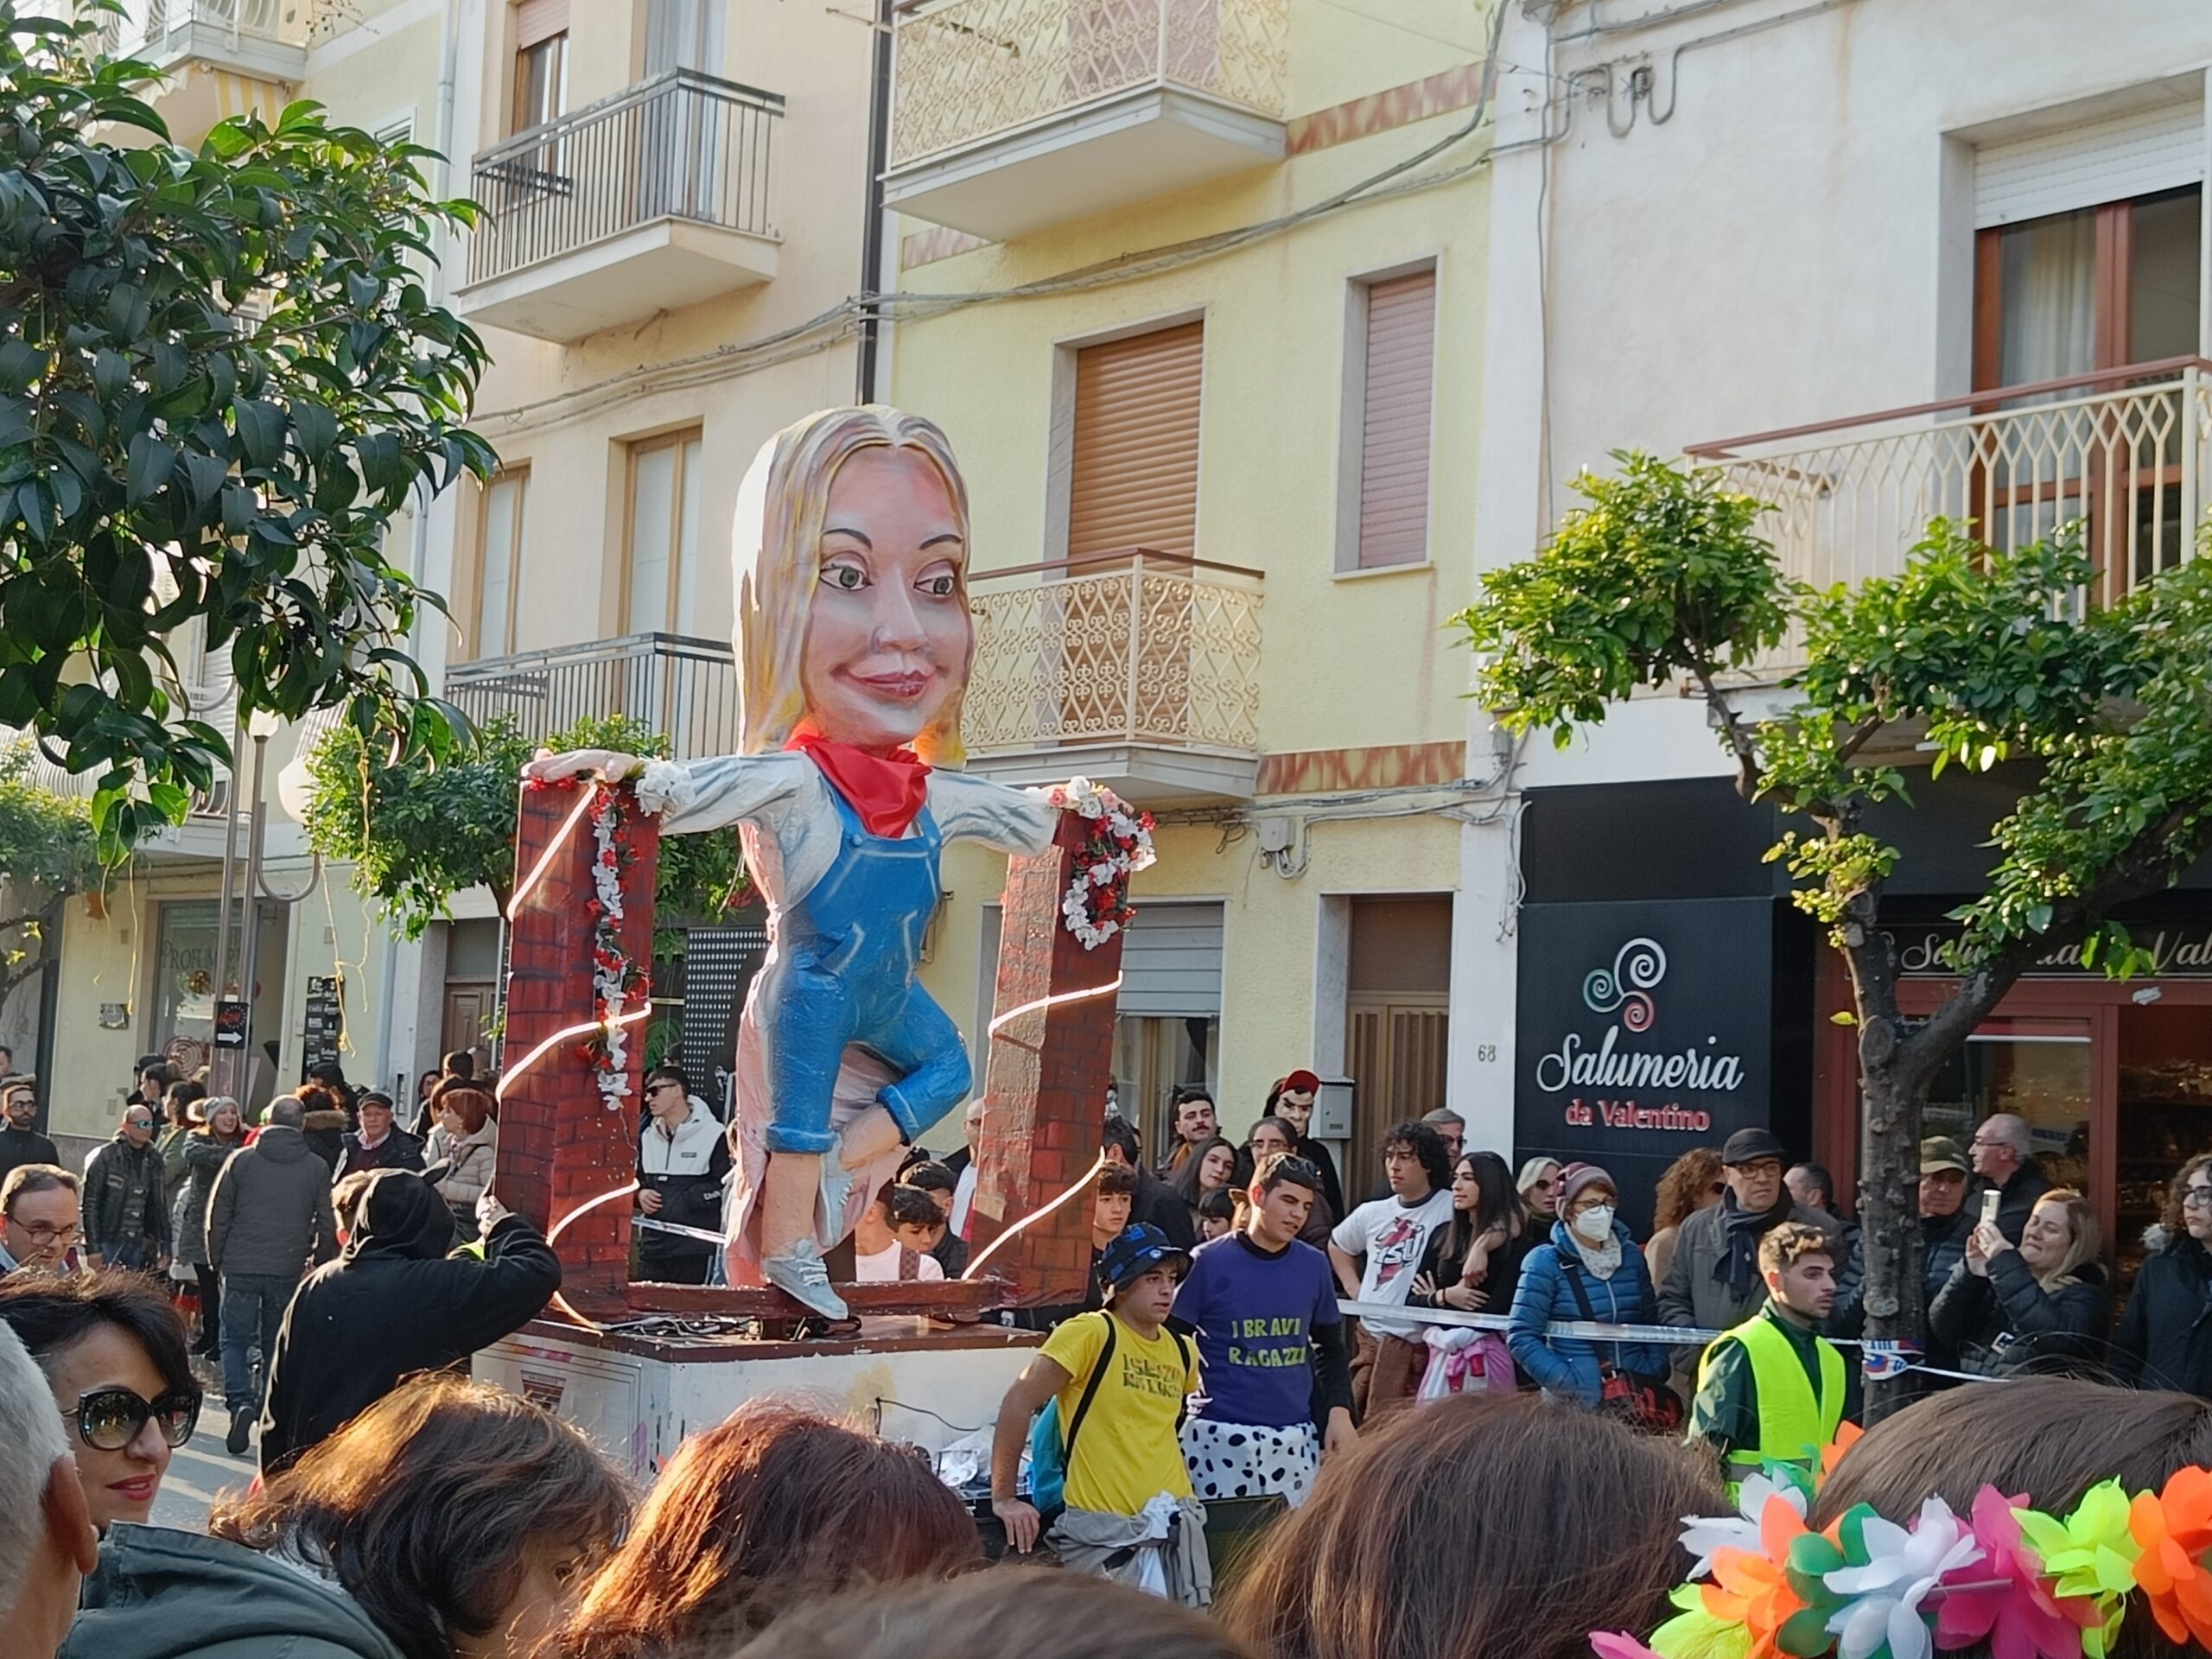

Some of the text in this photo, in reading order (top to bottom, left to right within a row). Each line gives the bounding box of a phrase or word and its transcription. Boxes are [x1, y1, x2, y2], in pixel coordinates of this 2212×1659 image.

[2152, 931, 2212, 970] Val
[1478, 1045, 1496, 1062] 68
[1536, 1025, 1745, 1092] Salumeria
[1566, 1099, 1711, 1132] da Valentino
[1231, 1318, 1301, 1339] I BRAVI
[1228, 1345, 1306, 1368] RAGAZZI
